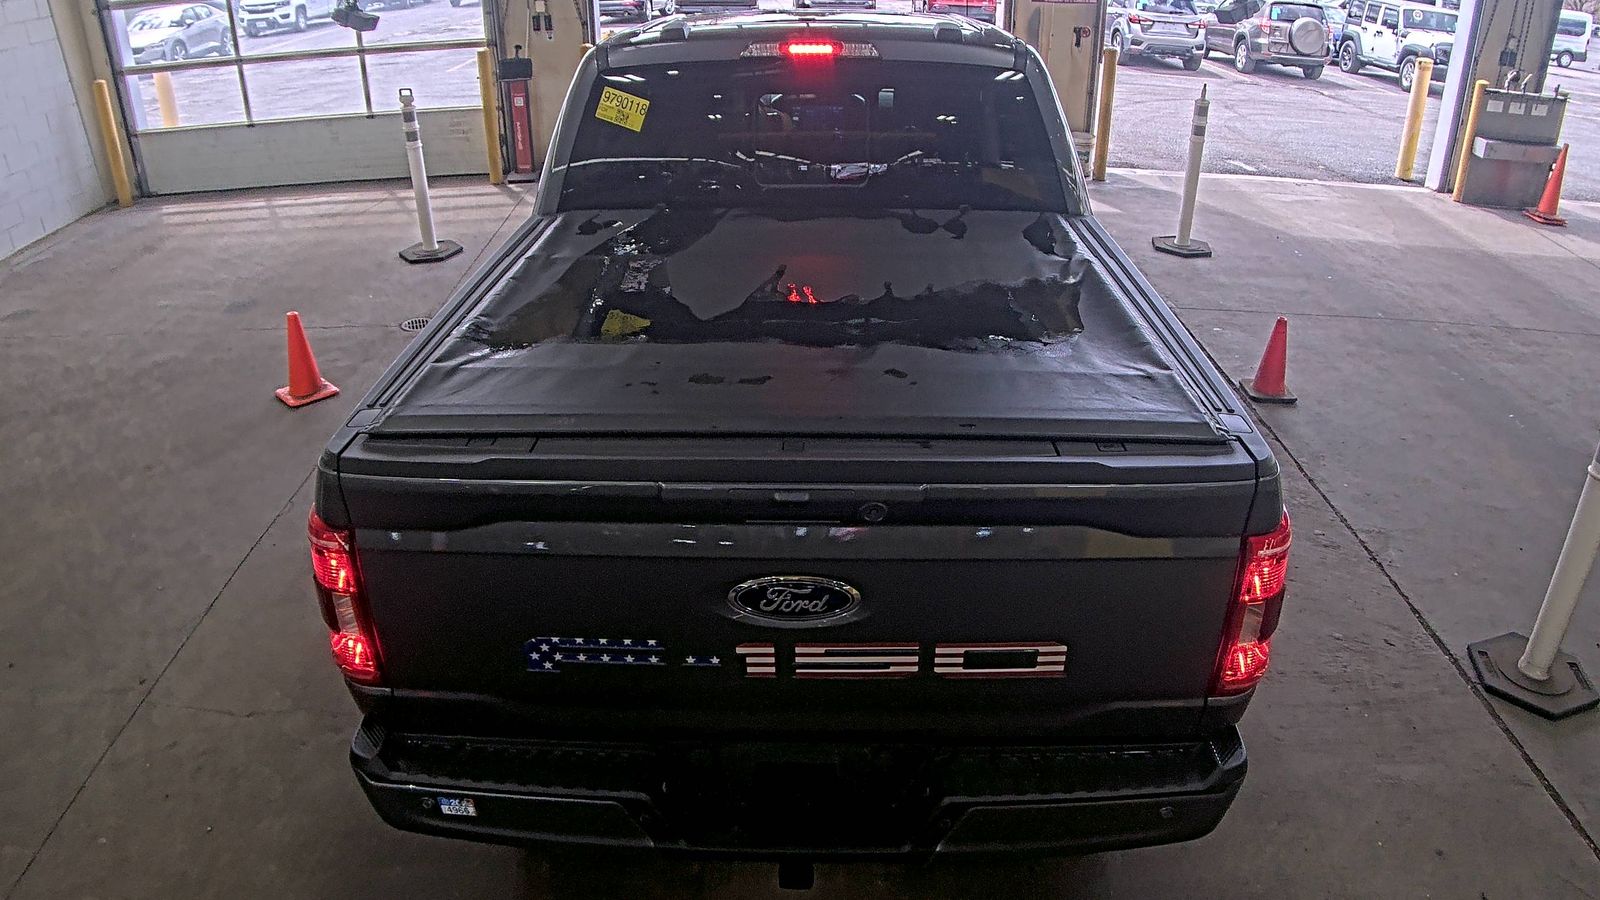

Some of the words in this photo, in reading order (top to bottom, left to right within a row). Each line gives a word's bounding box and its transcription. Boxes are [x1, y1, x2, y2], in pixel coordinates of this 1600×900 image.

[602, 90, 648, 116] 9790118
[760, 586, 829, 613] Ford
[523, 636, 1067, 679] F-150
